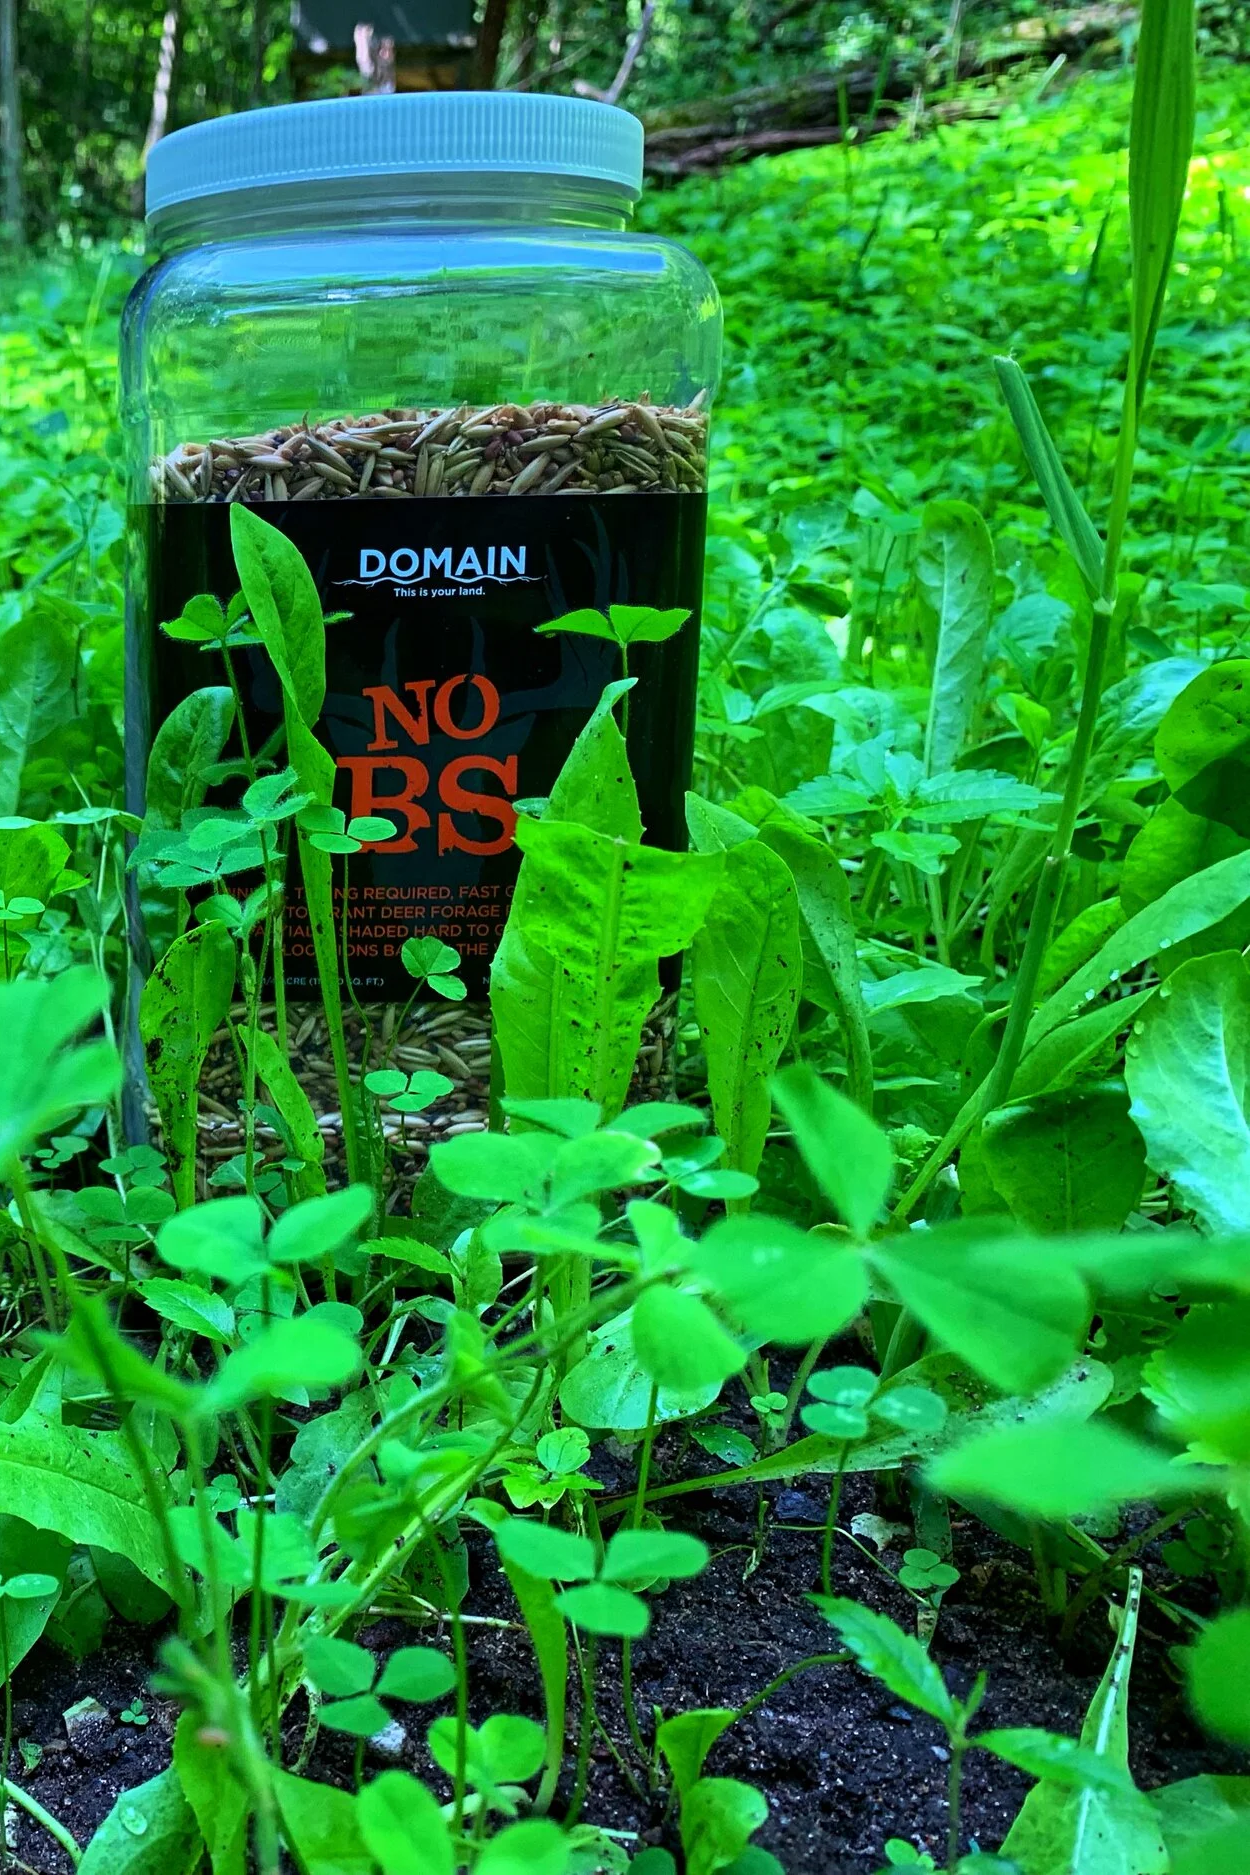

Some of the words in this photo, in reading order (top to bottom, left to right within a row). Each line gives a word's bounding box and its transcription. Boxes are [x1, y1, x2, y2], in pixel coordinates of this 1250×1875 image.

[360, 546, 526, 577] DOMAIN
[394, 587, 416, 597] This
[419, 587, 428, 597] is
[431, 587, 455, 598] your
[459, 586, 486, 596] land.
[362, 673, 500, 751] NO
[336, 755, 518, 856] BS
[363, 886, 453, 900] REQUIRED,
[459, 885, 500, 898] FAST
[381, 905, 425, 919] DEER
[430, 904, 500, 918] FORAGE
[414, 924, 462, 937] HARD
[467, 923, 489, 937] TO
[458, 943, 488, 956] THE
